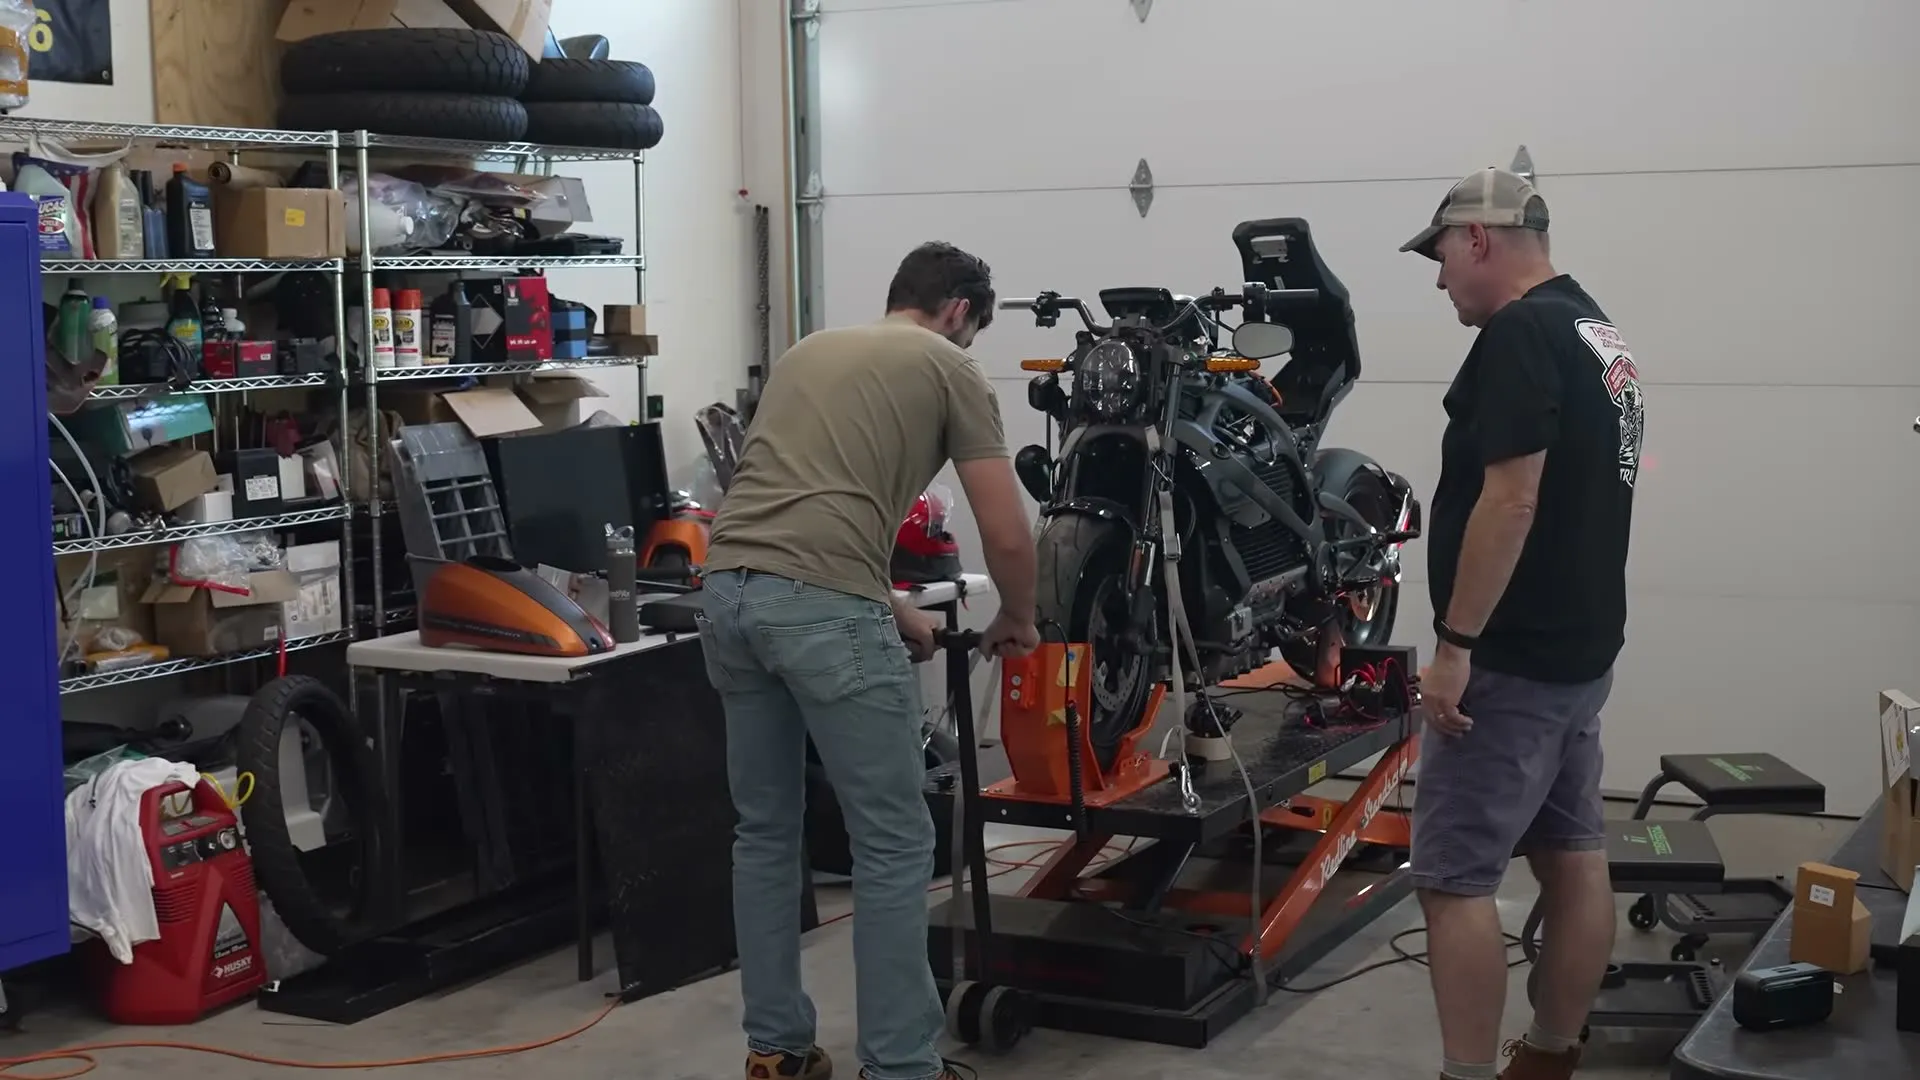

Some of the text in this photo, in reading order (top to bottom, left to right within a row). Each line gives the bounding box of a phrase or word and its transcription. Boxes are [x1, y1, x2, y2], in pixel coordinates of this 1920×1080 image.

[28, 8, 53, 51] 6
[39, 200, 66, 214] UCAS
[224, 955, 252, 974] HUSKY
